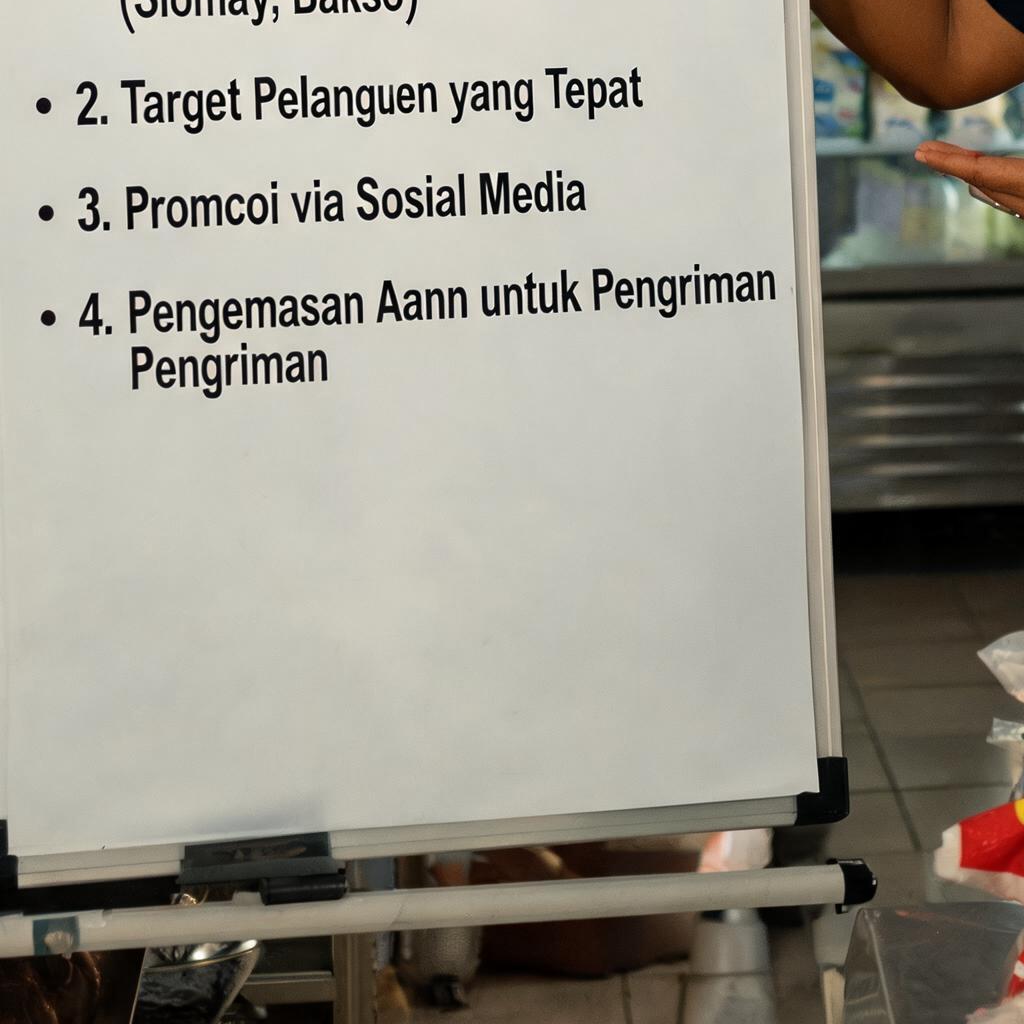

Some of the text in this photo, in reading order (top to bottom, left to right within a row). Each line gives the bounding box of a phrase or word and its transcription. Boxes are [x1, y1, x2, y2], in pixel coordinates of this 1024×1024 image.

[75, 66, 644, 135] 2. Target Pelanguen yang Tepat
[77, 169, 587, 232] 3. Promcoi via Sosial Media
[78, 263, 776, 344] 4. Pengemasan Aann untuk Pengriman
[131, 342, 328, 399] Pengriman
